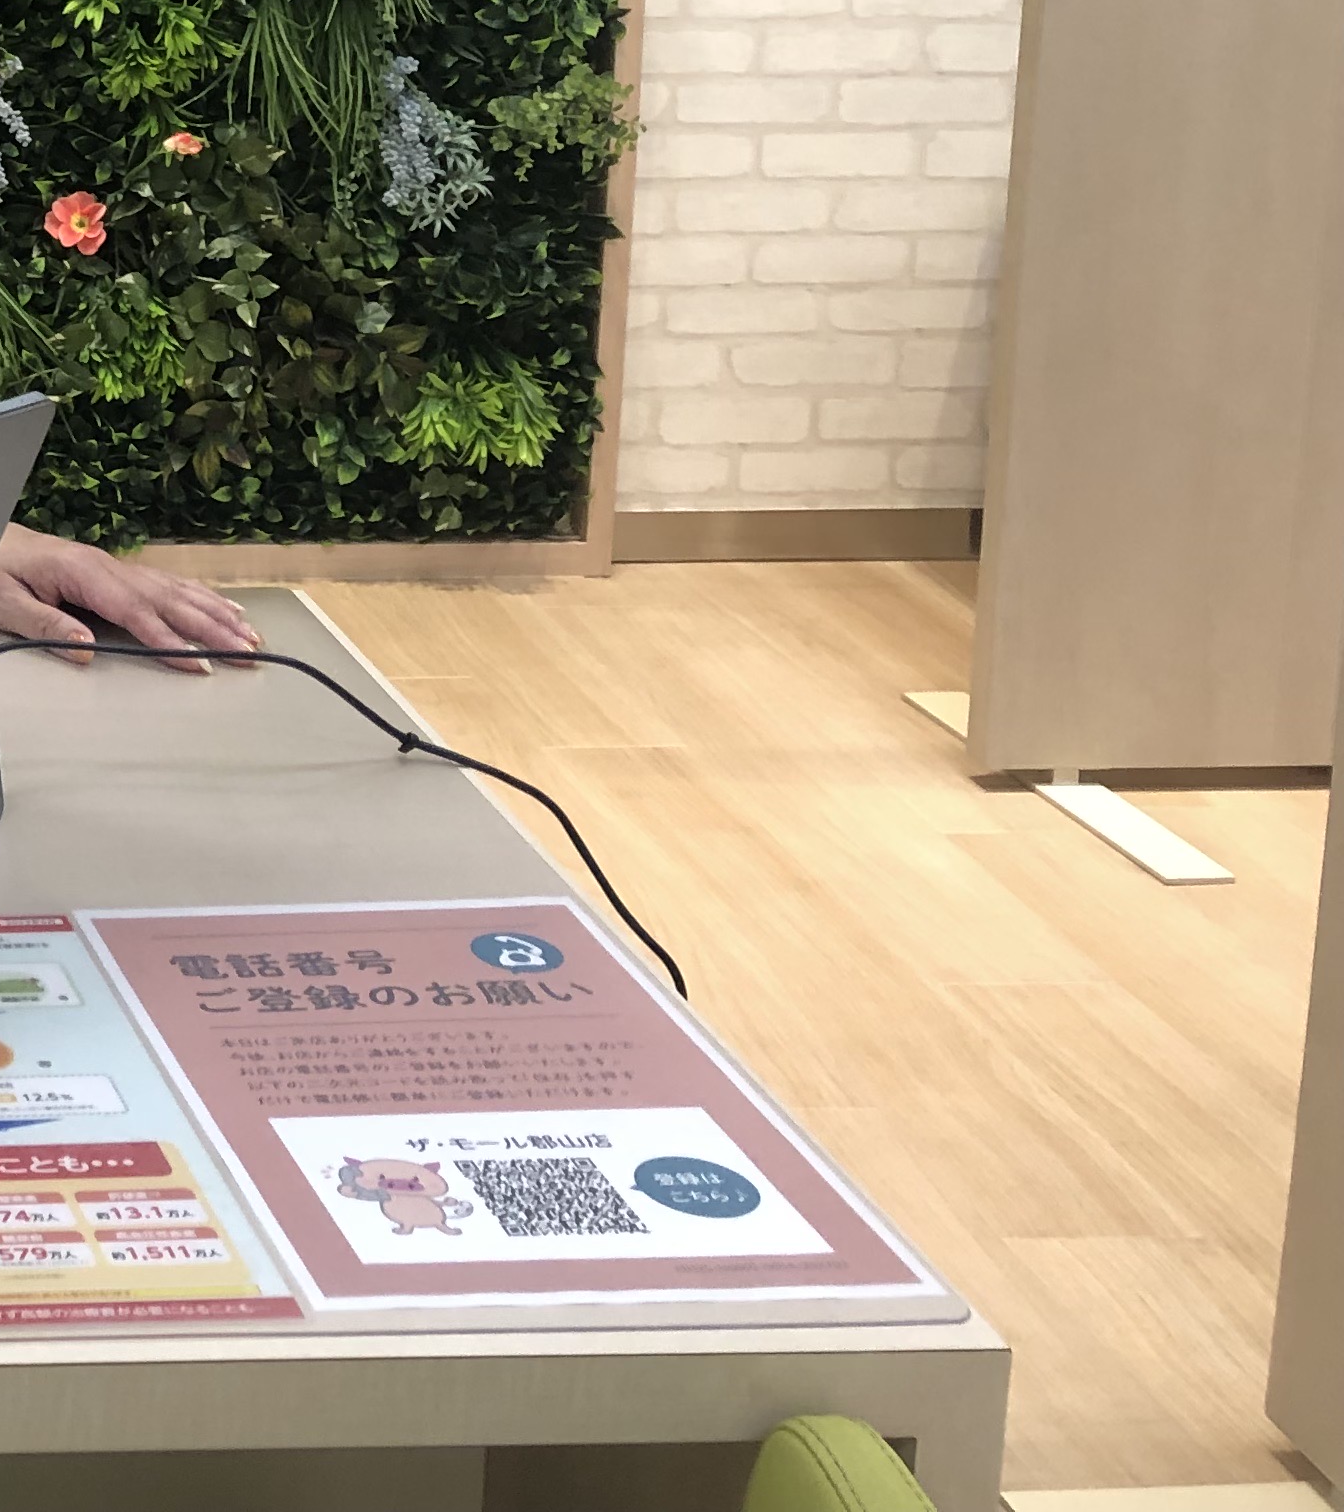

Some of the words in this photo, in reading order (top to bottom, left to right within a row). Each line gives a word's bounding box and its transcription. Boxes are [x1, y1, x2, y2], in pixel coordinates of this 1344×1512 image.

[170, 949, 397, 980] 電話番号
[196, 979, 595, 1013] ご登録のお願い
[405, 1133, 613, 1151] ザ・モール郡山店
[96, 1205, 194, 1221] 約13.1万人
